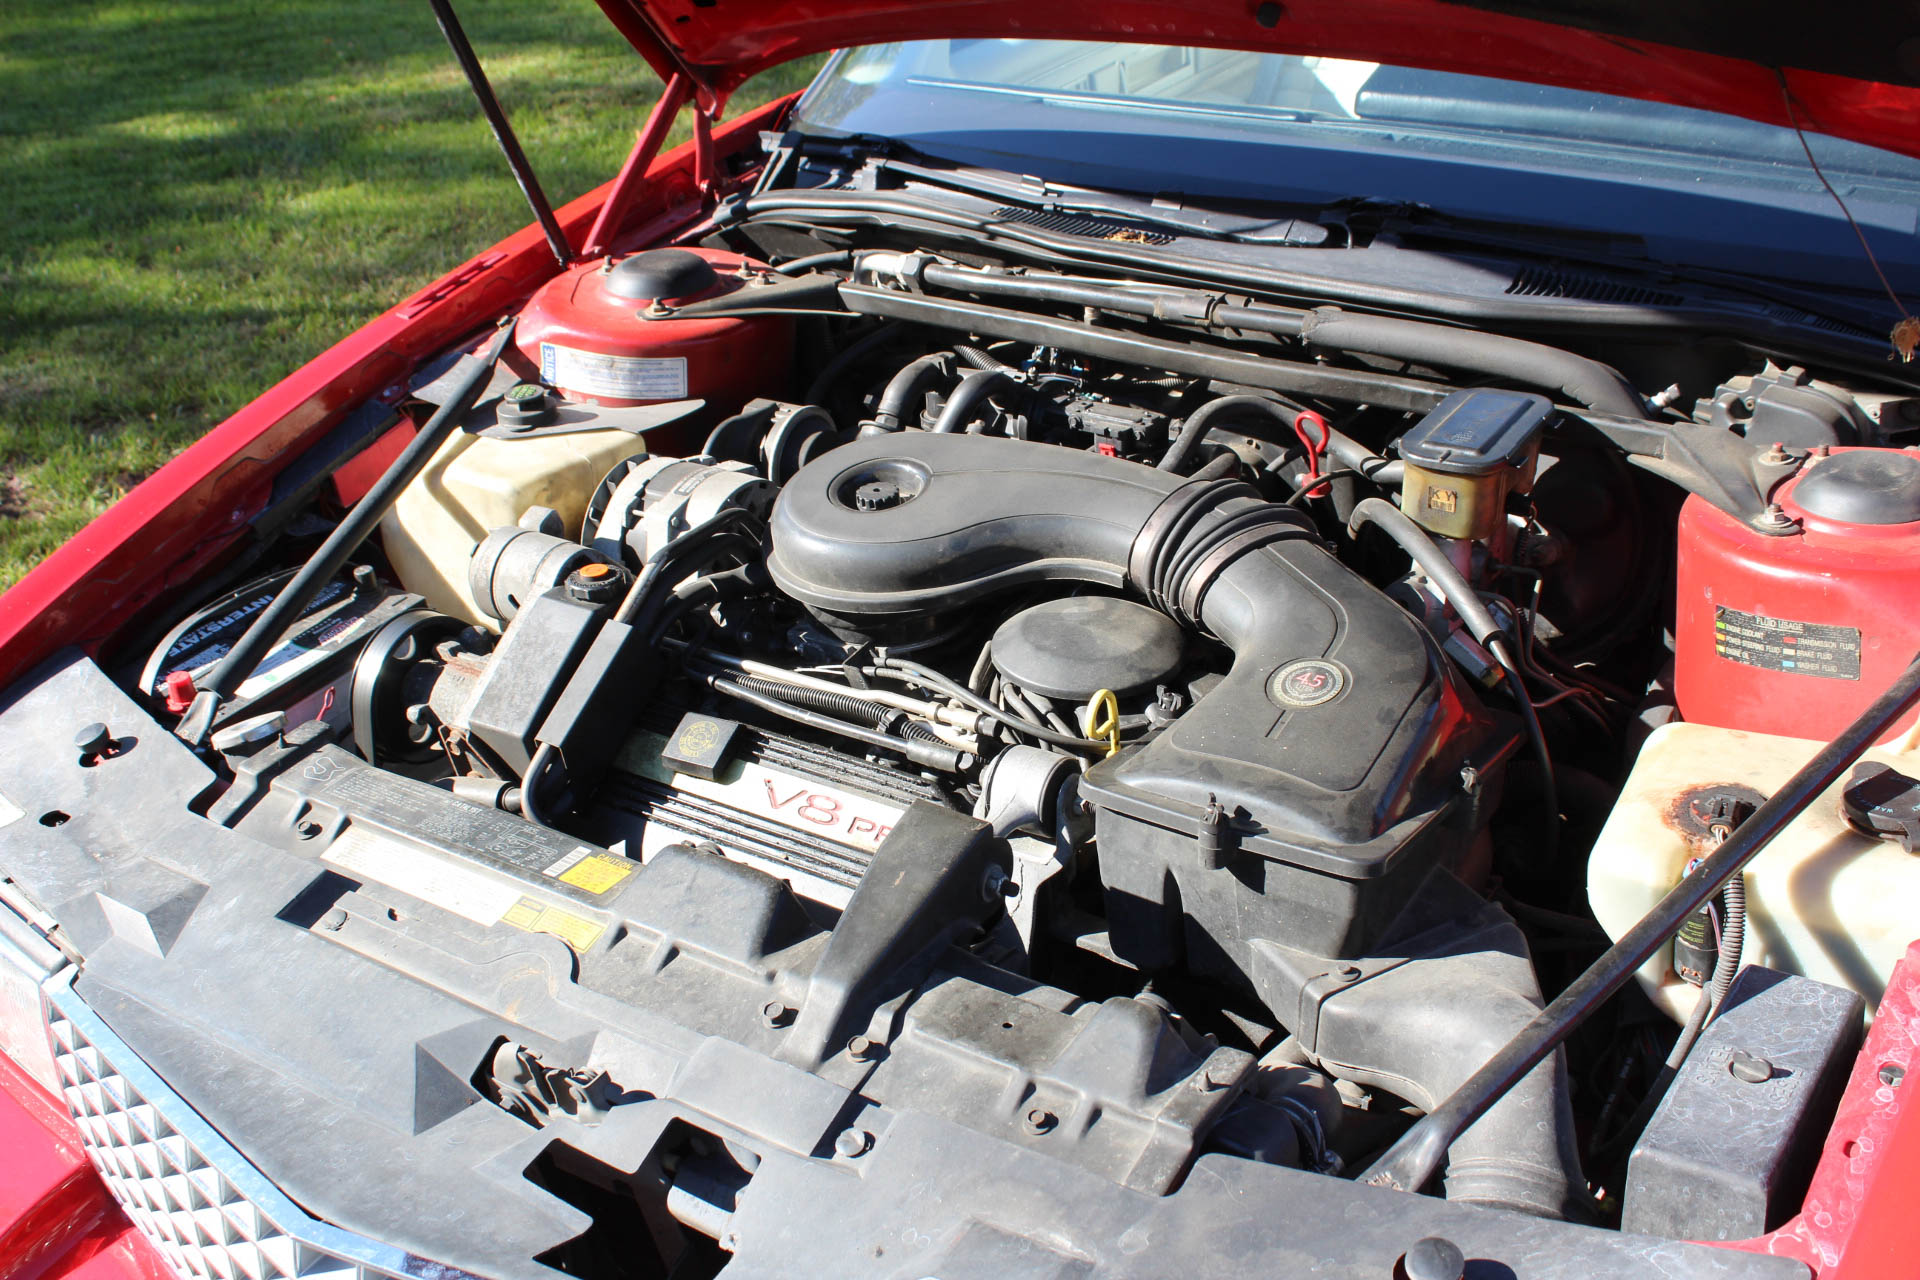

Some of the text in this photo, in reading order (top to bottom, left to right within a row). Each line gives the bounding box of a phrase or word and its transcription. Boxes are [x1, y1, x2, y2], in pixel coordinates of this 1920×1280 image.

[1756, 616, 1805, 632] FLUID USAGE
[1726, 624, 1764, 639] ENGINE COOLANT
[1742, 640, 1765, 652] STEERING
[1766, 645, 1781, 654] FLUID
[1797, 638, 1856, 651] TRANSMISSION FLUID
[1797, 649, 1833, 661] BRAKE FLUID
[1797, 662, 1838, 673] WASHER FLUID
[764, 777, 844, 826] V8
[596, 853, 633, 871] CAUTION
